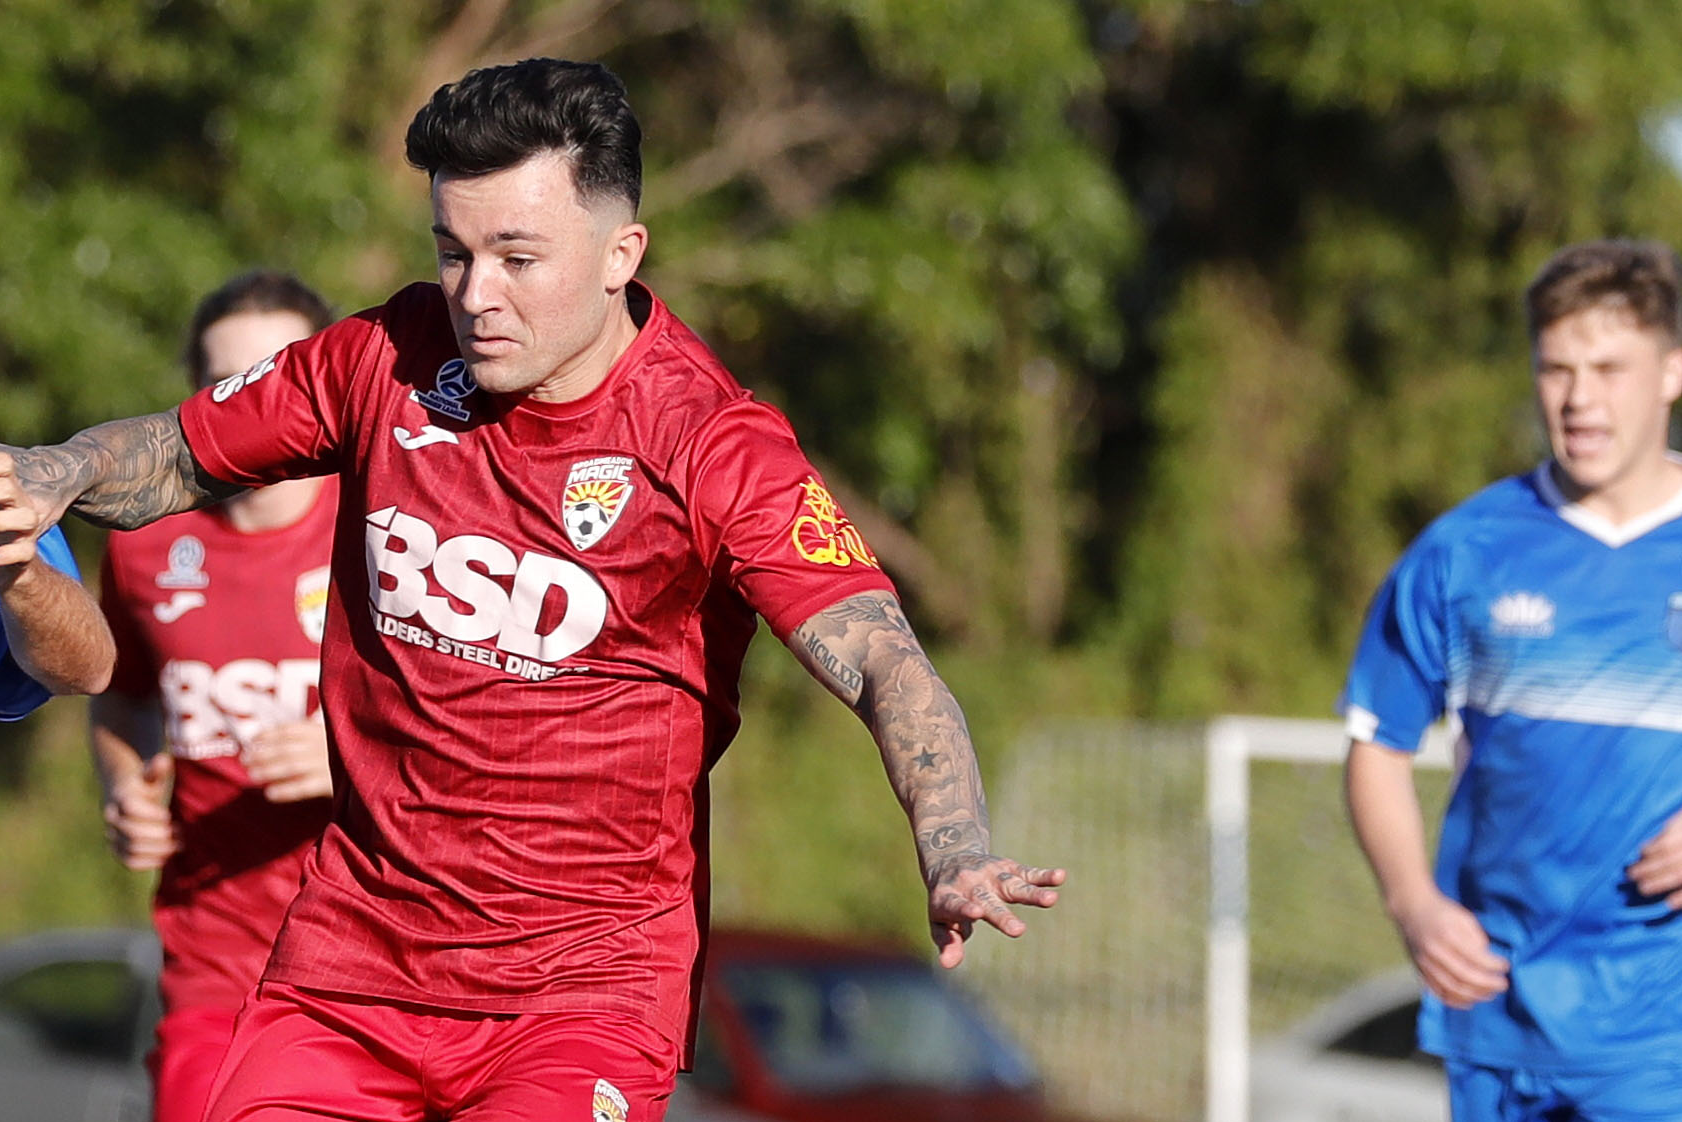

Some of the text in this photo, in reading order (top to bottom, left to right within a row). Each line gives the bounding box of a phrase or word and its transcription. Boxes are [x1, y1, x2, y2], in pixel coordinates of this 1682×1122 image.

[566, 465, 632, 486] MAGIC
[365, 505, 608, 663] BSD
[369, 603, 590, 681] LDERS STEEL DIRE
